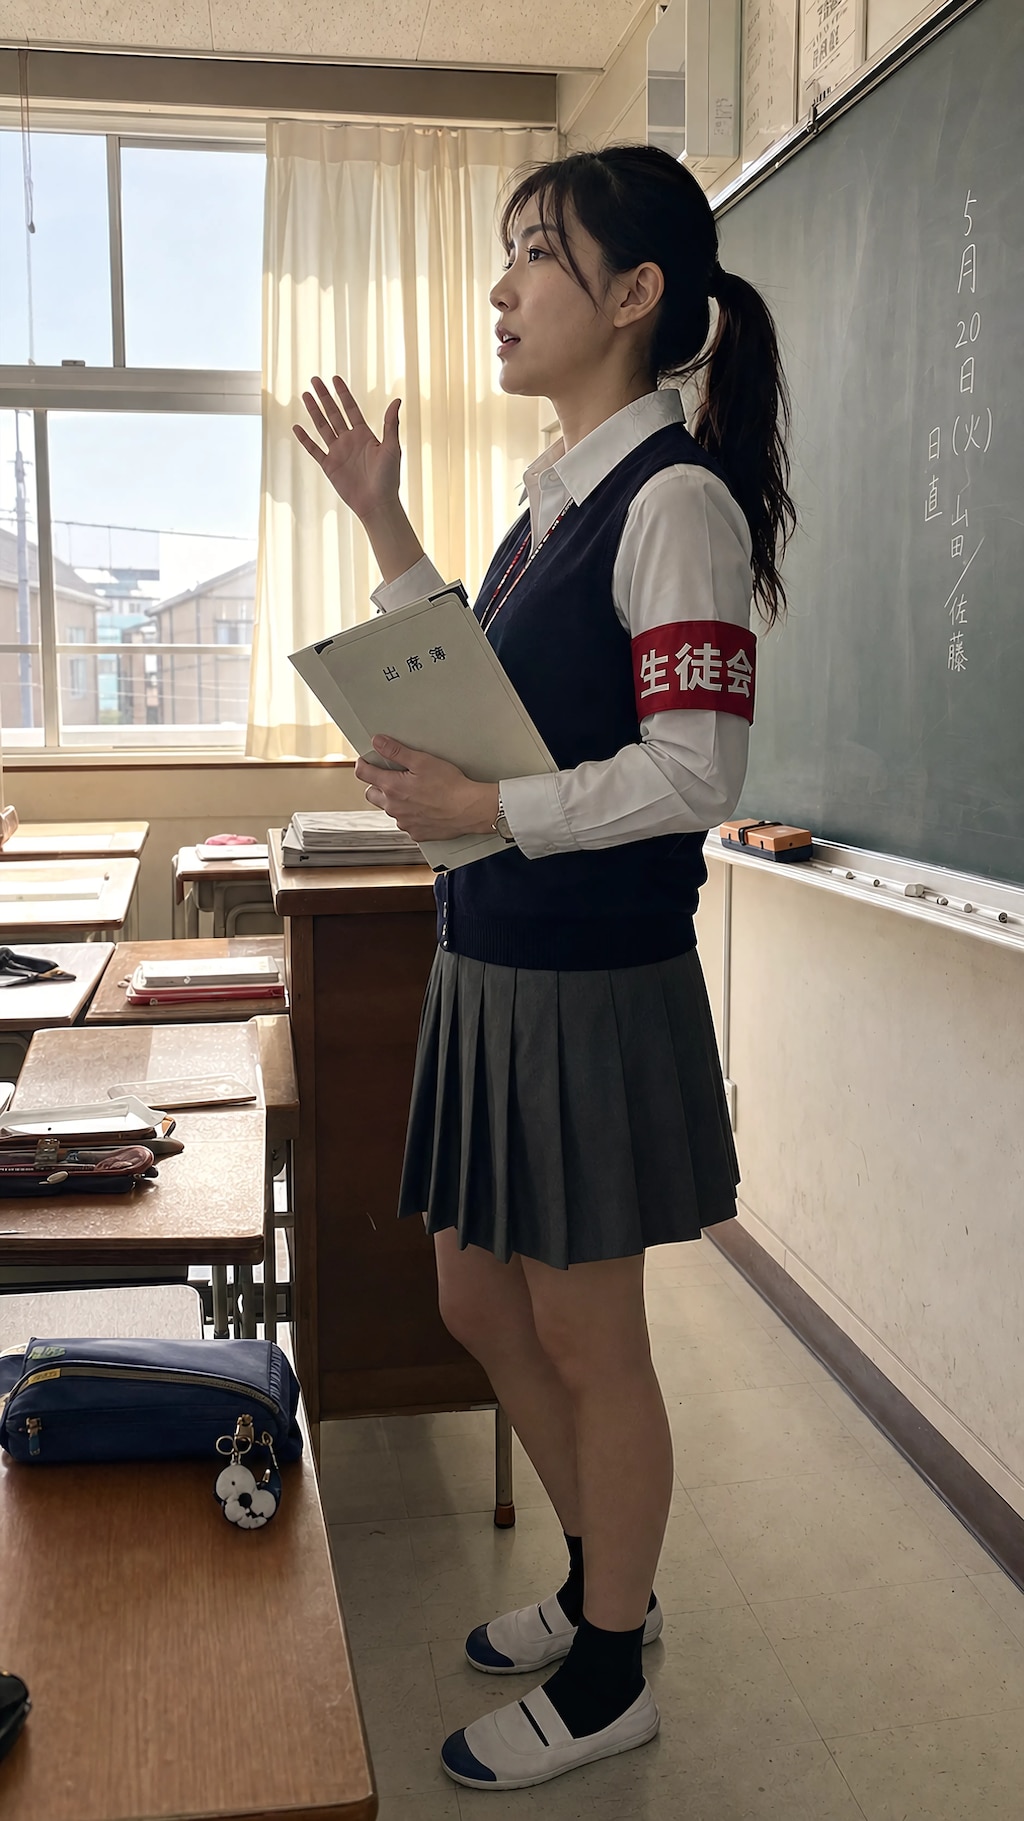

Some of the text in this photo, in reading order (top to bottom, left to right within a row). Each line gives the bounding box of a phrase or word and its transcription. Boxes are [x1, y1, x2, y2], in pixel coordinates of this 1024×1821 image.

[924, 426, 943, 522] 日直
[382, 645, 447, 682] 出席簿
[639, 642, 753, 699] 生徒会
